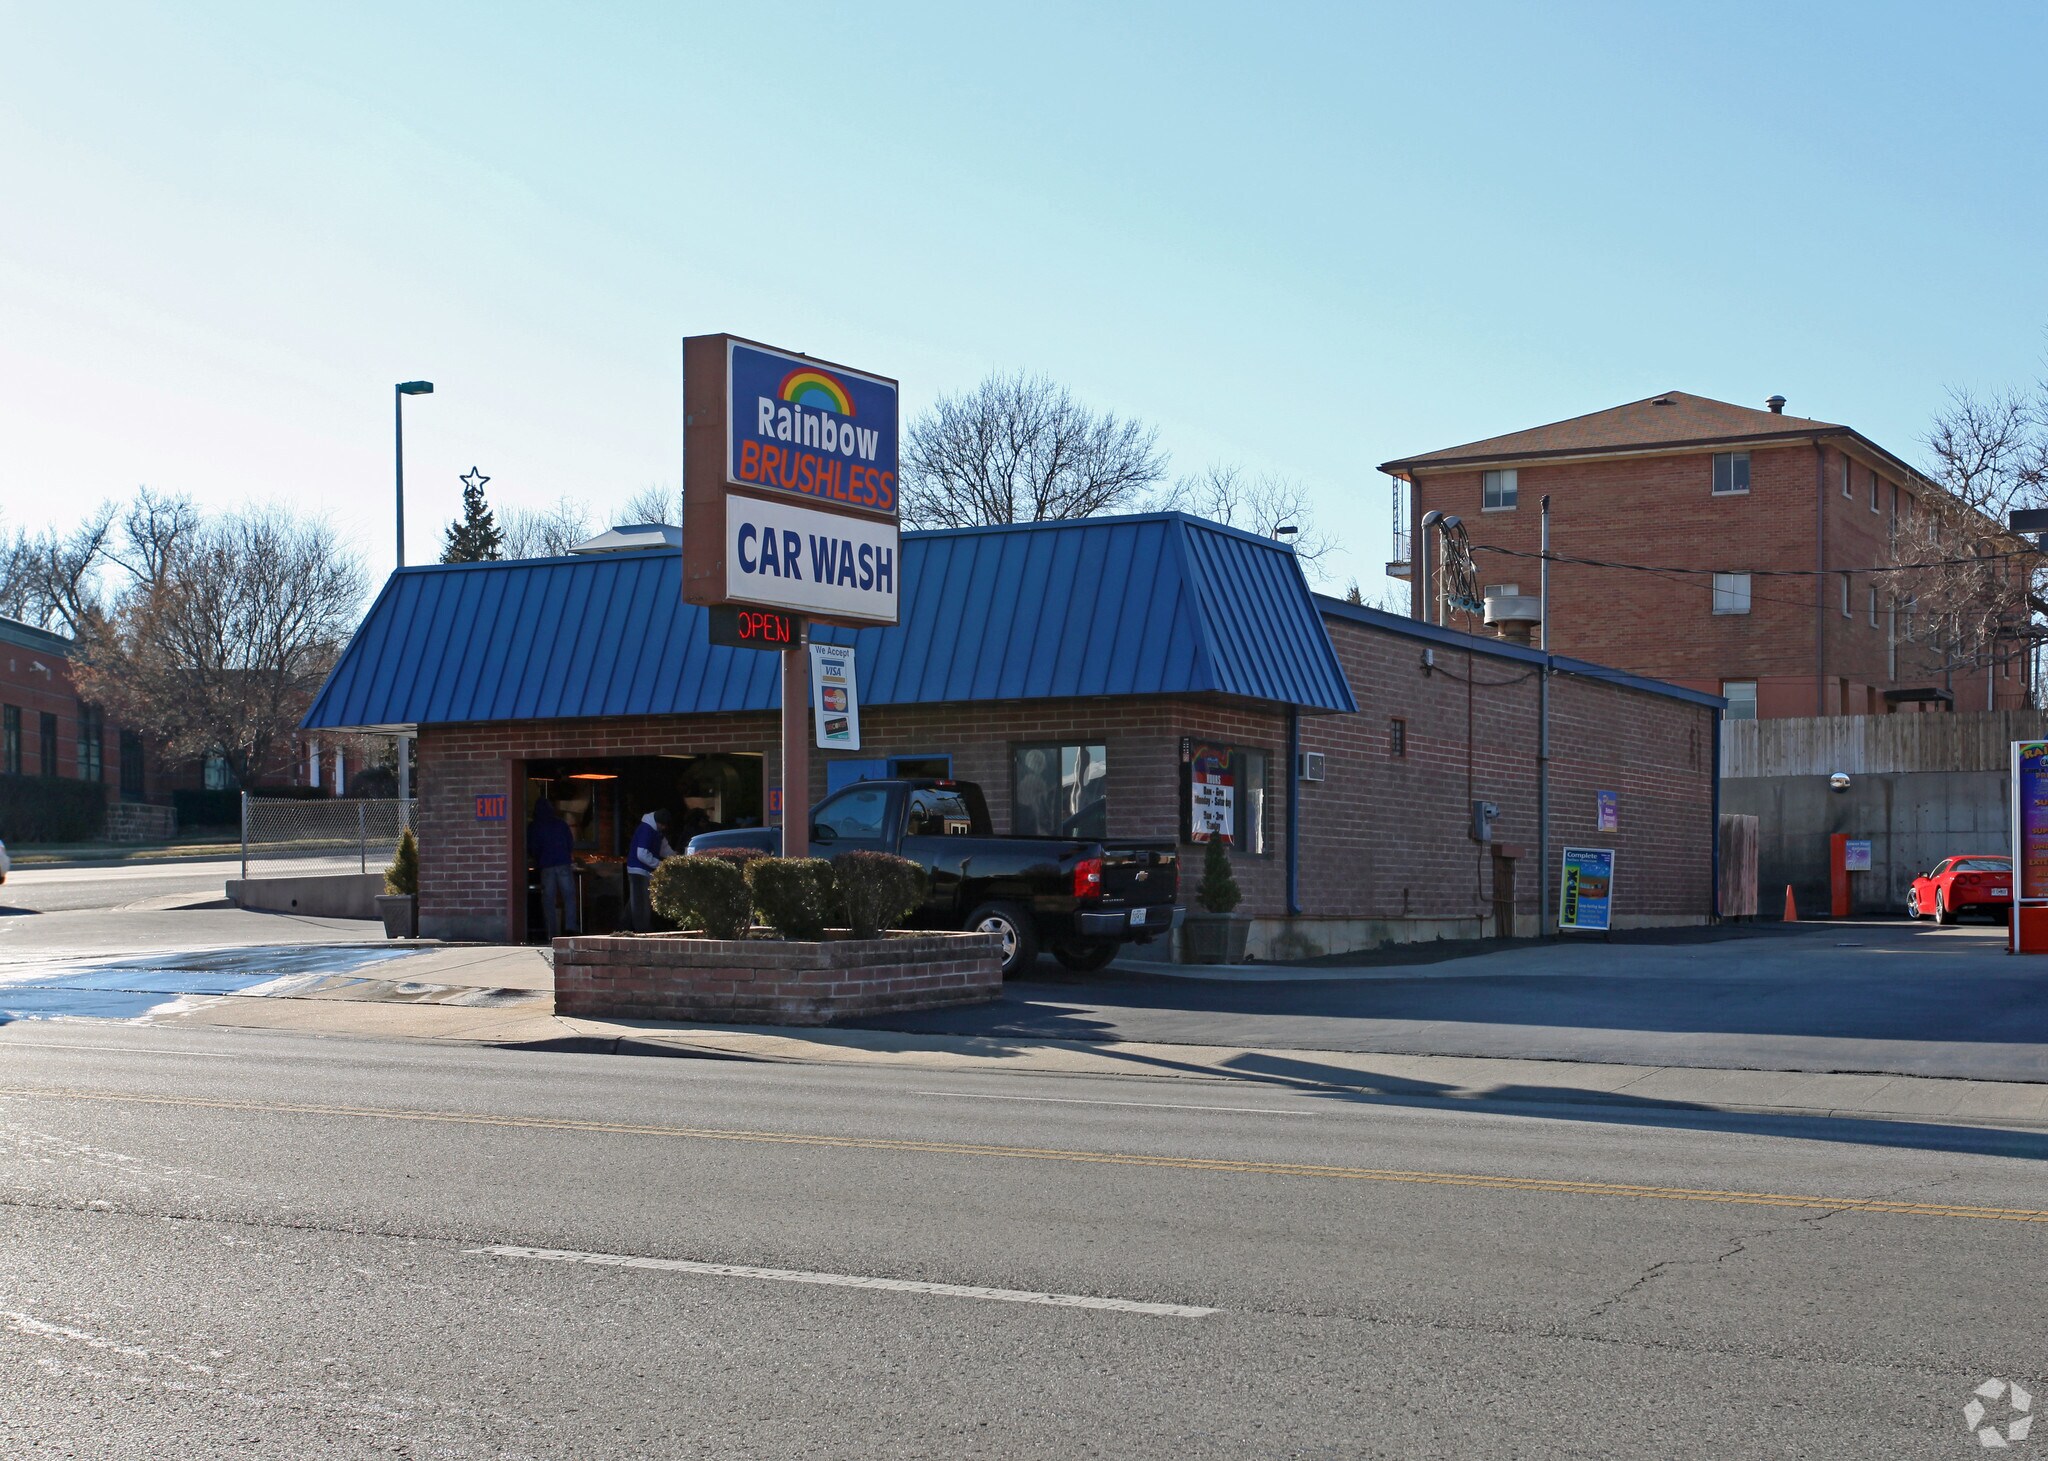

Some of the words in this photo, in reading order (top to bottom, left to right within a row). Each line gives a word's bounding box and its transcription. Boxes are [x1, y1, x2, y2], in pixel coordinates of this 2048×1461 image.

[758, 396, 879, 461] Rainbow
[740, 439, 894, 510] BRUSHLESS
[737, 522, 803, 581] CAR
[809, 534, 893, 594] WASH
[738, 611, 790, 643] OPEN
[815, 645, 826, 655] We
[827, 646, 850, 659] Accept
[825, 666, 842, 677] VISA
[477, 798, 505, 817] EXIT
[1567, 851, 1598, 860] Complete
